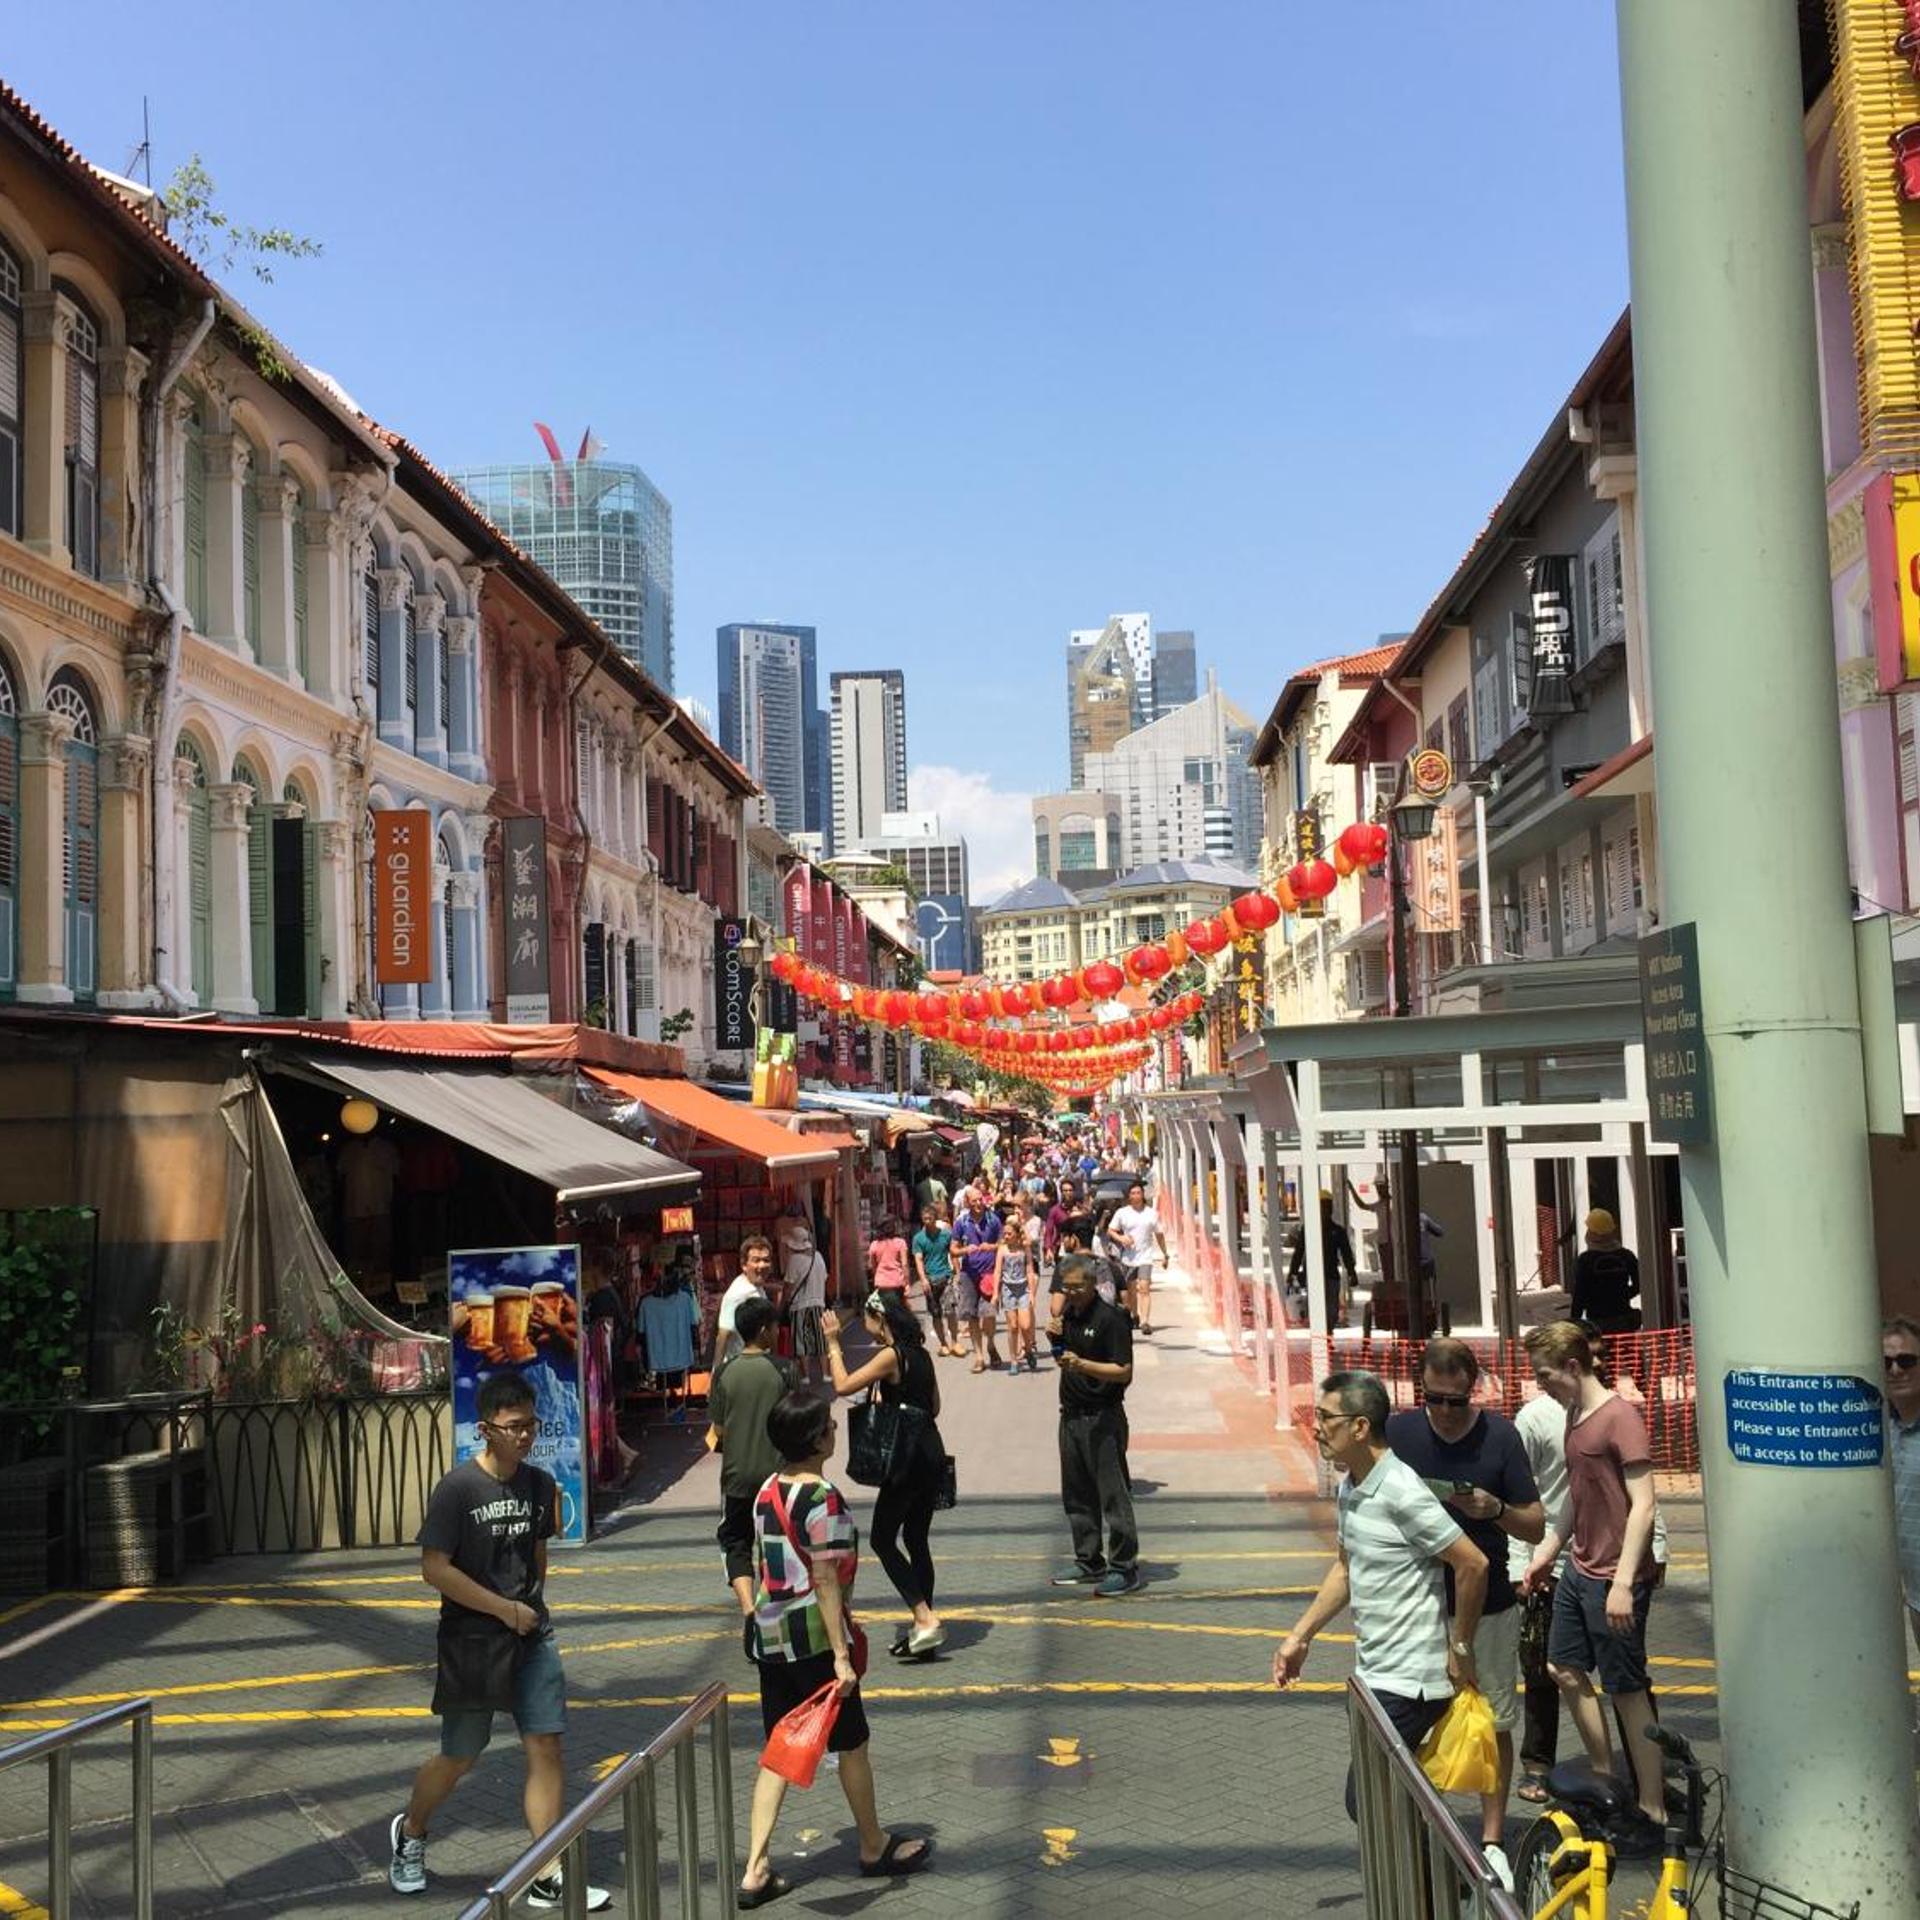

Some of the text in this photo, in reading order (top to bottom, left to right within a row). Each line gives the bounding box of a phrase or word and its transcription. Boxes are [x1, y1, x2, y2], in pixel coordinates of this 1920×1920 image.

[1532, 591, 1570, 633] 5
[387, 852, 416, 966] guardian
[791, 882, 804, 953] CHINATOWN
[835, 915, 847, 976] CHINATOWN
[1678, 1007, 1698, 1029] Clear
[1731, 1372, 1756, 1387] This
[1759, 1375, 1820, 1390] Entrance
[1823, 1377, 1833, 1389] is
[1732, 1398, 1797, 1413] accessible
[1800, 1402, 1814, 1414] to
[1817, 1401, 1840, 1414] the
[1733, 1419, 1774, 1436] Please
[1776, 1424, 1800, 1437] use
[1804, 1424, 1860, 1438] Entrance
[1861, 1422, 1869, 1436] C
[1734, 1442, 1751, 1457] lift
[1754, 1448, 1797, 1461] access
[1800, 1448, 1814, 1461] to
[1817, 1448, 1840, 1462] the
